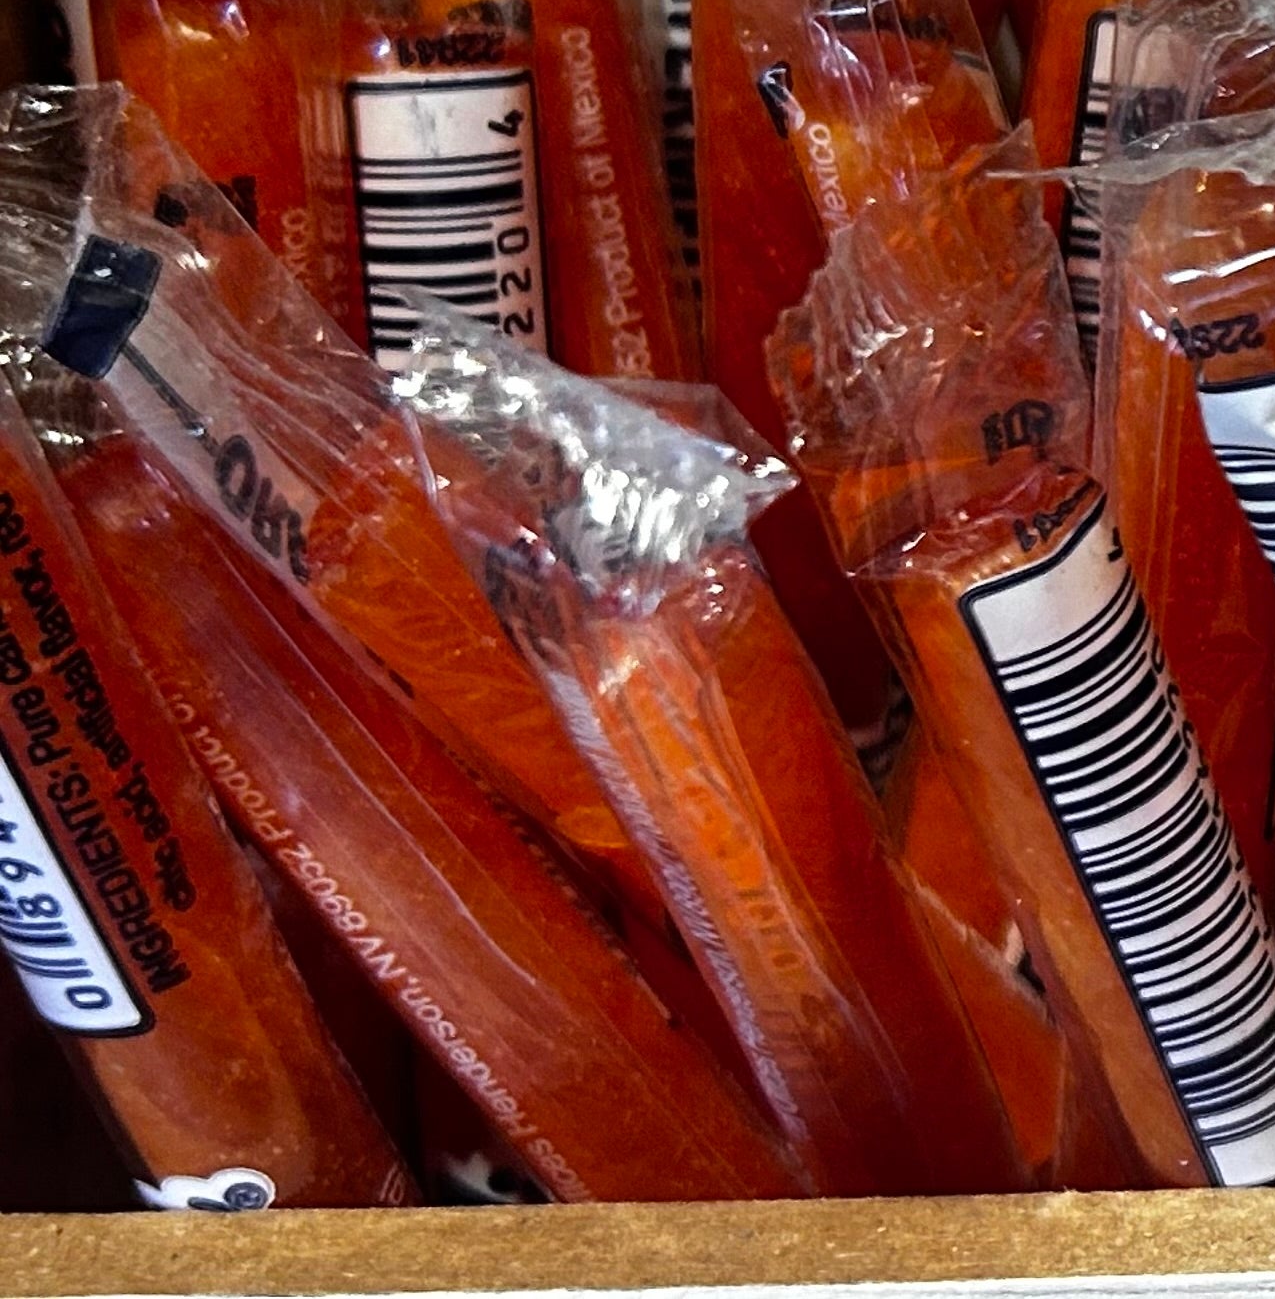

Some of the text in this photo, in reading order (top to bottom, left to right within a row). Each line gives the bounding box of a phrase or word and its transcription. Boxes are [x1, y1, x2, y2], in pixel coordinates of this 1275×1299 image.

[558, 21, 609, 148] Mexico
[580, 148, 616, 190] of
[583, 187, 644, 326] Product
[1, 546, 78, 659] flavor,
[7, 685, 74, 770] Pure
[46, 648, 138, 774] artificial
[104, 759, 173, 847] acid,
[183, 722, 296, 850] Product
[38, 758, 192, 995] INGREDIENTS:
[276, 836, 370, 942] 89052
[63, 972, 113, 1021] 0
[342, 922, 409, 989] NV
[389, 971, 542, 1148] Henderson,
